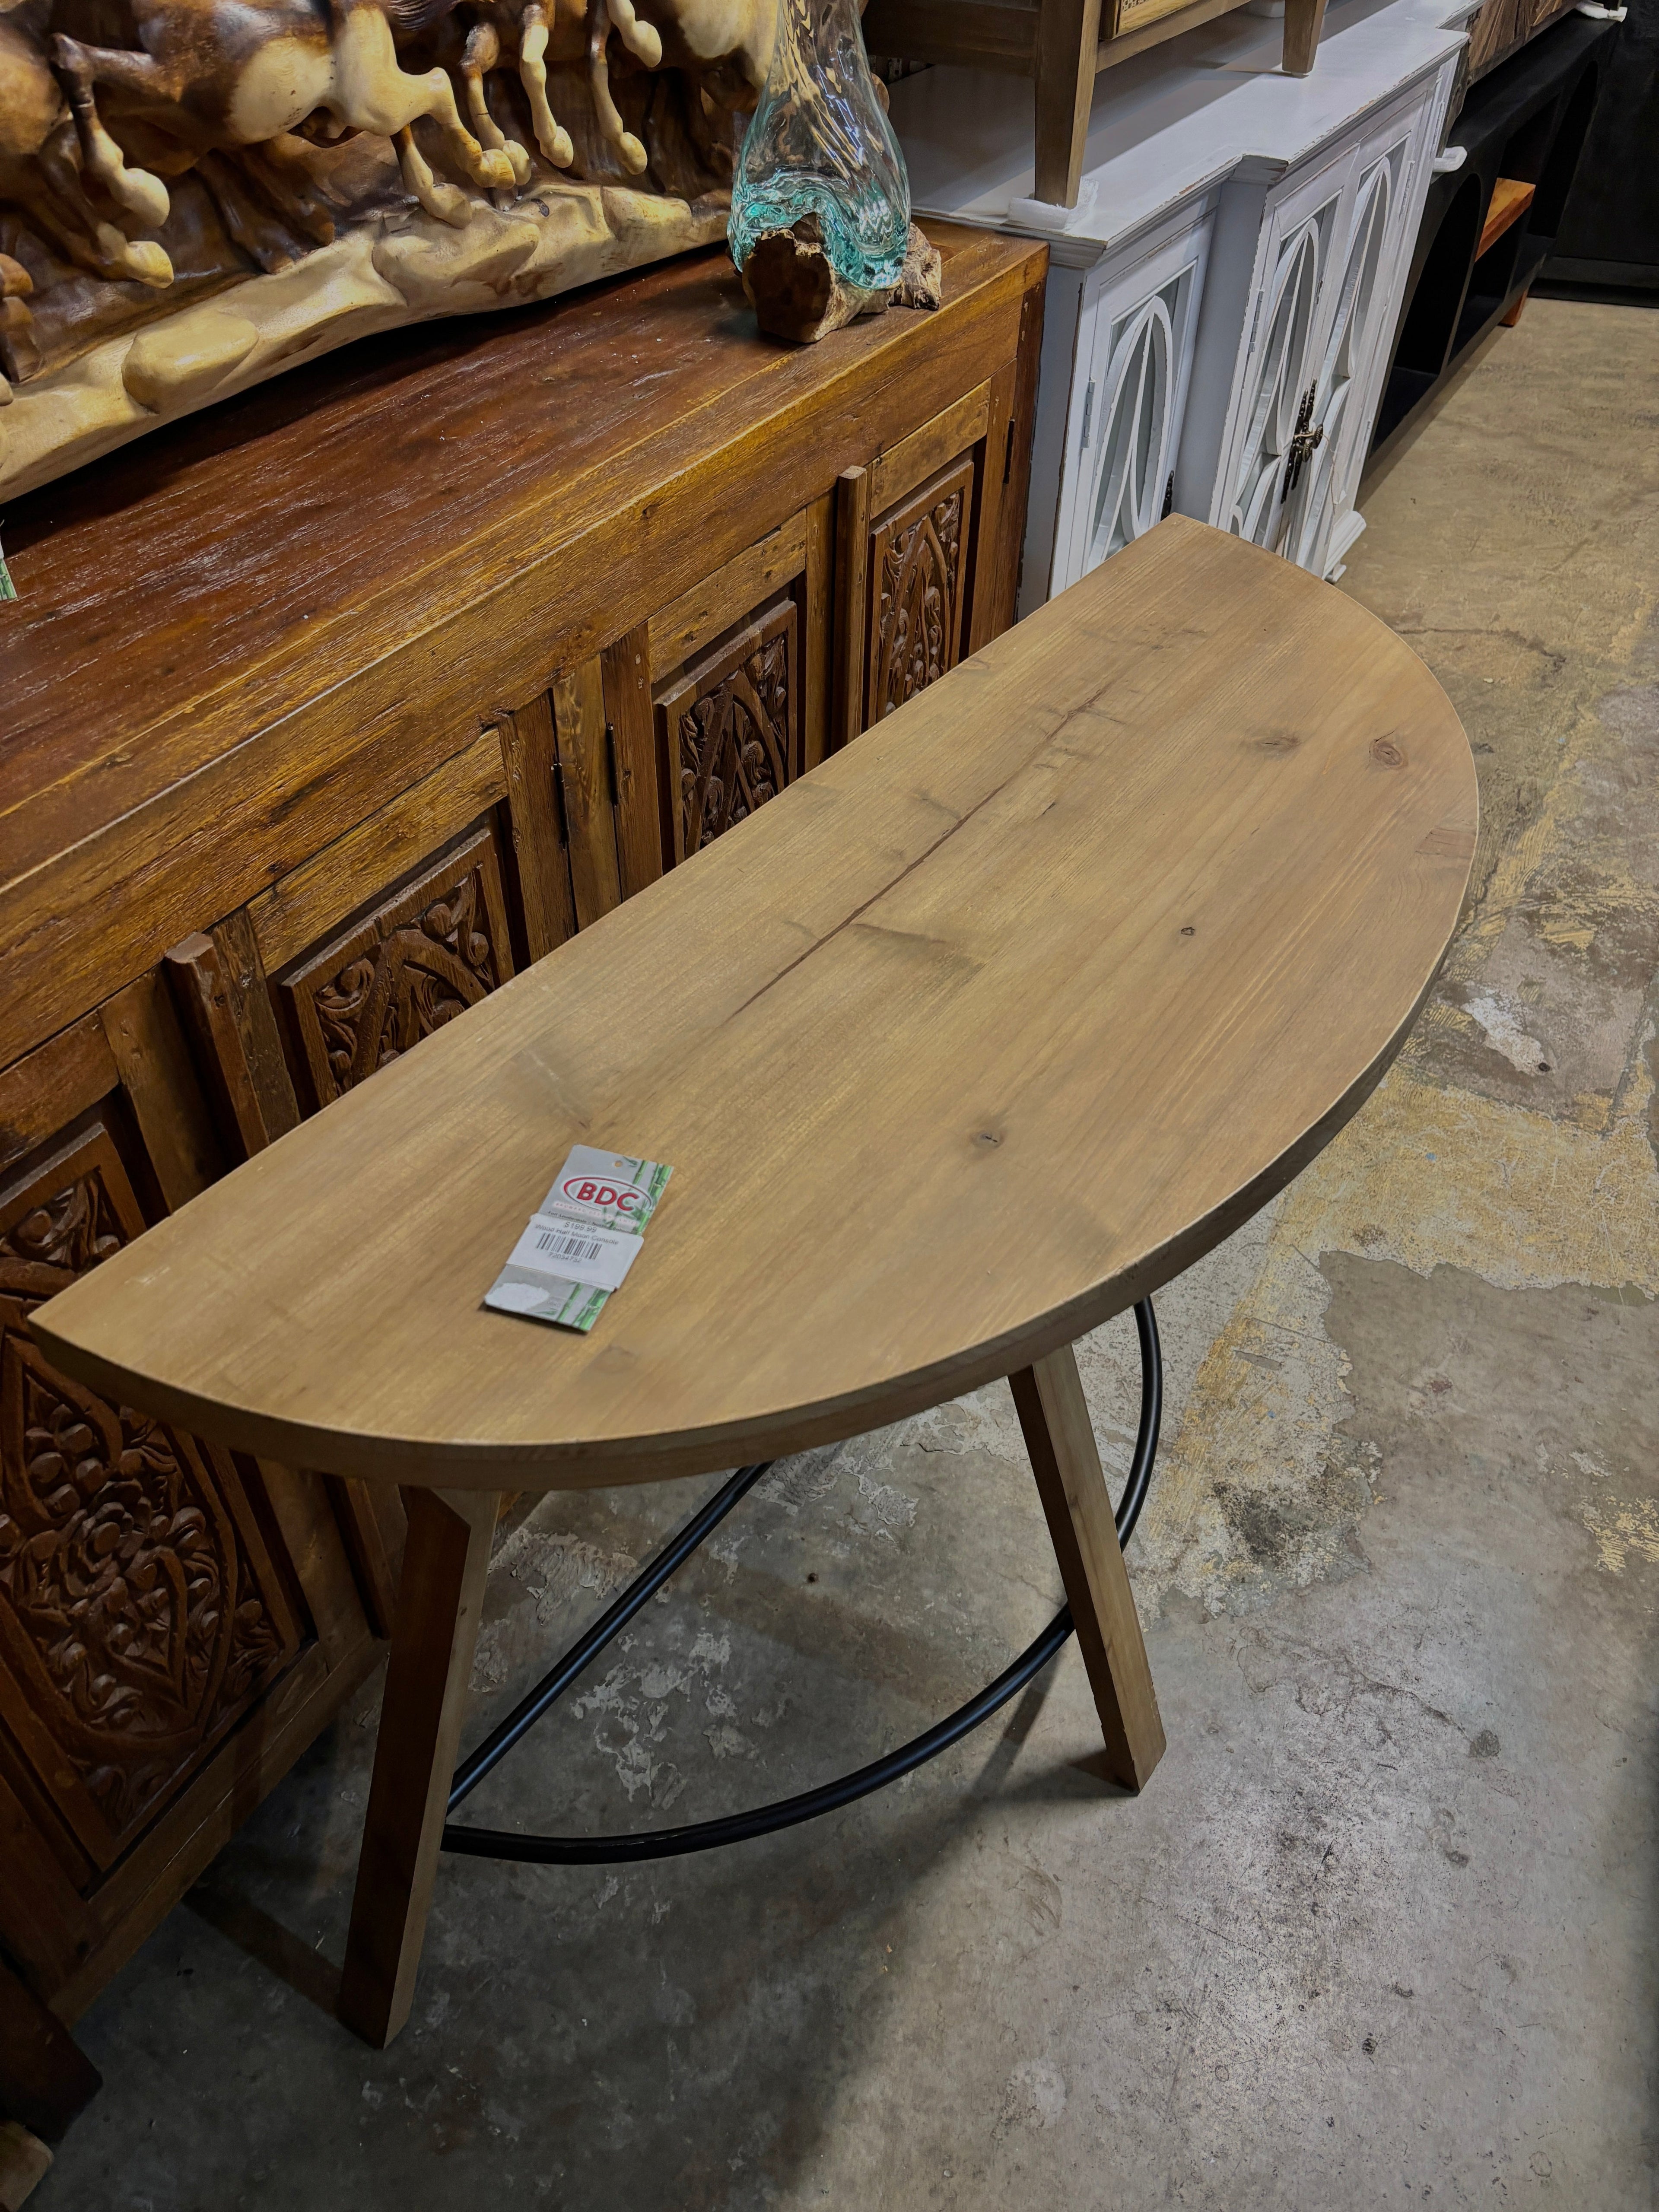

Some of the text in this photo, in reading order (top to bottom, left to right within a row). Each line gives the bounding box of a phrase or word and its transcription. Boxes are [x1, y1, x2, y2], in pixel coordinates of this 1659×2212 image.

[576, 1182, 640, 1211] BDC
[536, 1224, 555, 1232] Wood
[592, 1235, 619, 1245] Console
[565, 1221, 597, 1233] $199.99
